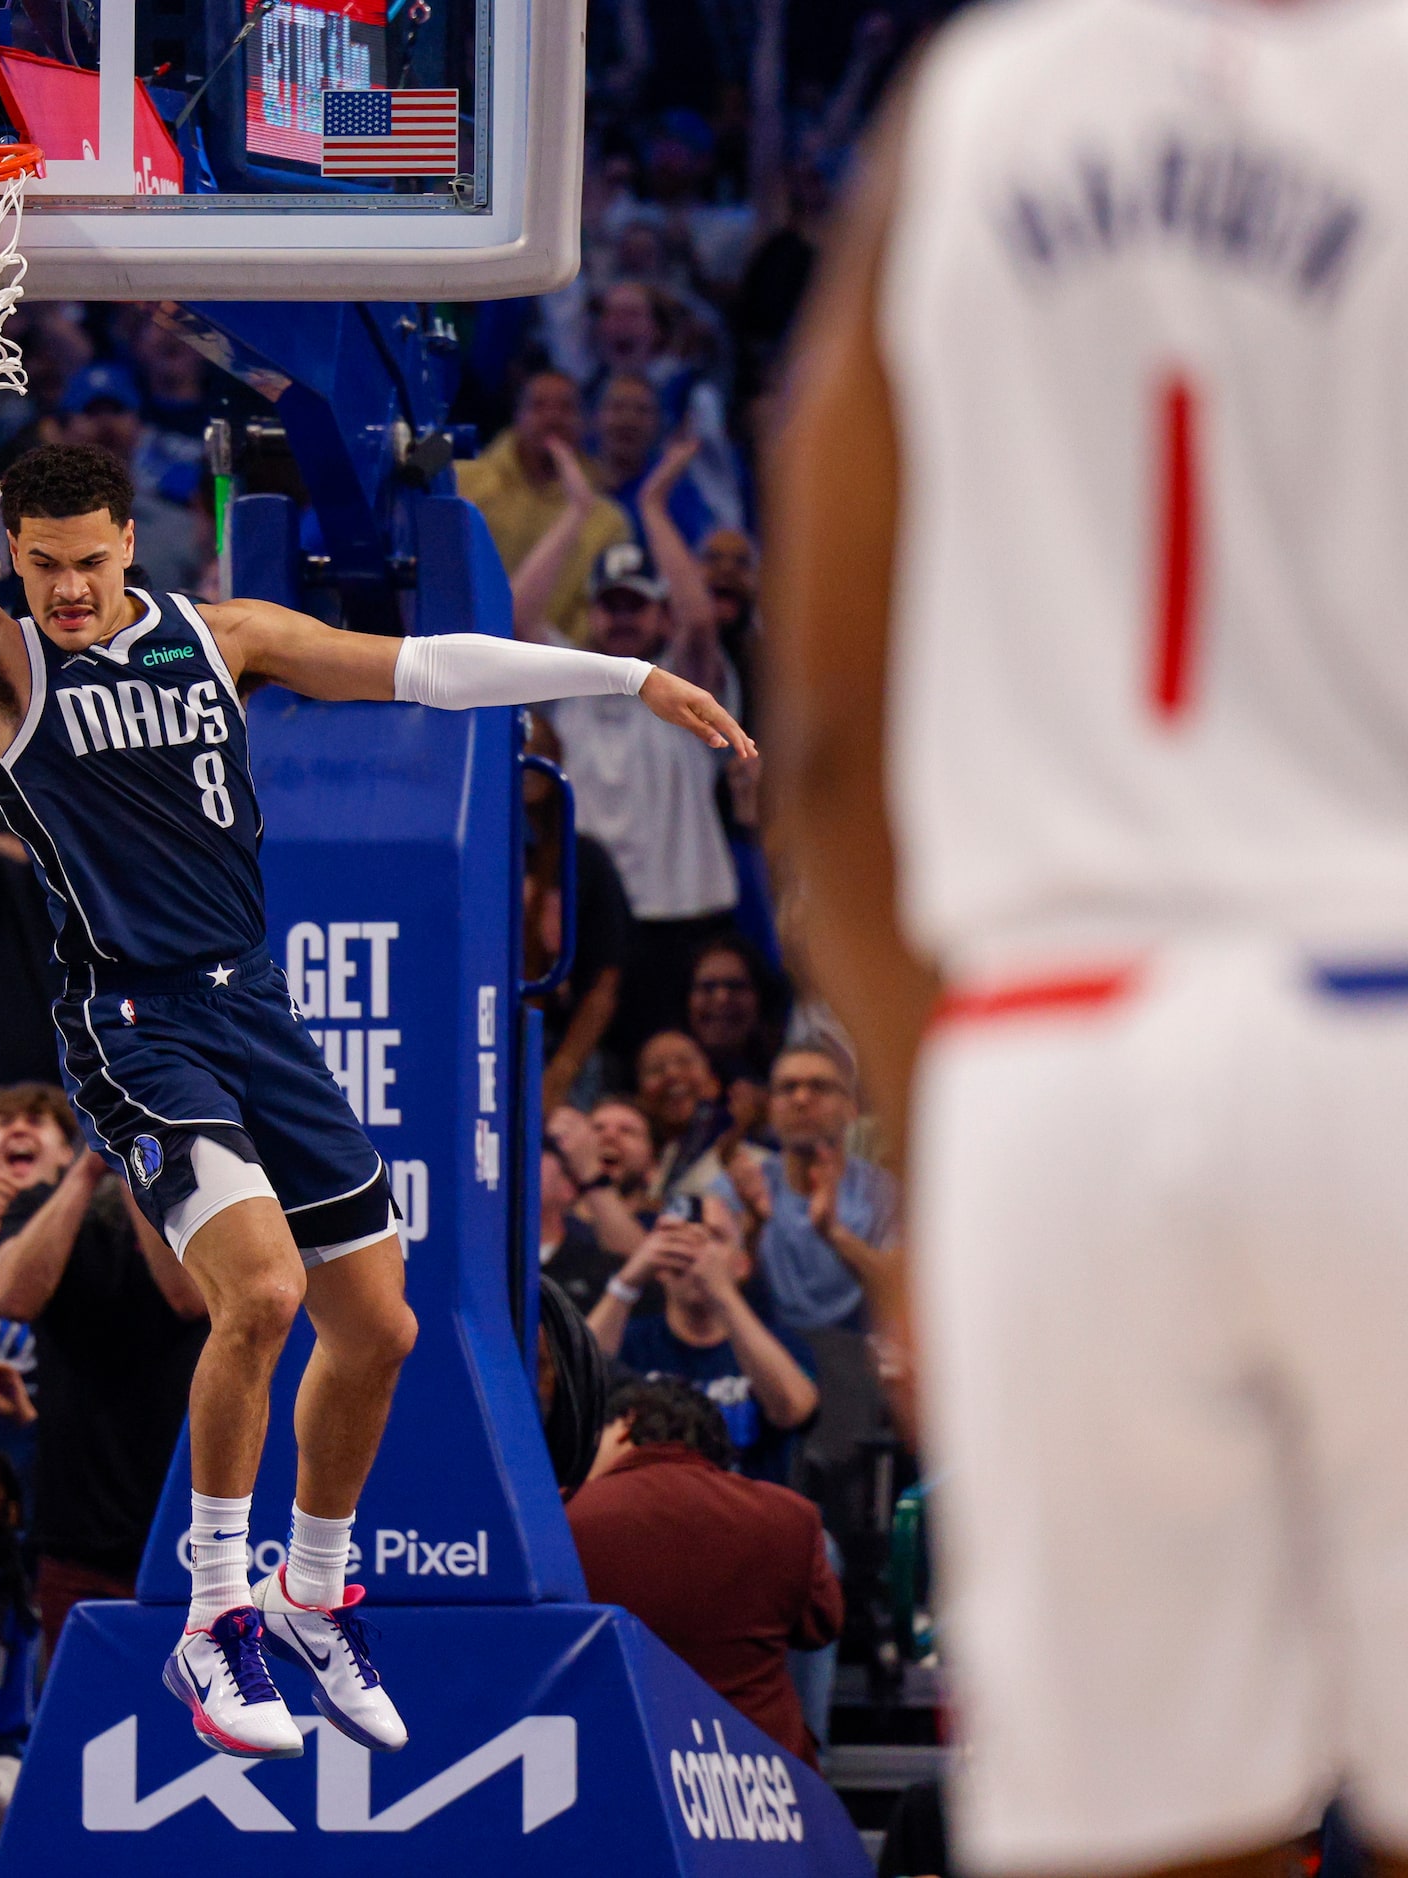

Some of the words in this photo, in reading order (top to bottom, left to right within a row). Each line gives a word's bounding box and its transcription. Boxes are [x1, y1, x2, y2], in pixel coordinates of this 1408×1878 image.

[143, 646, 195, 667] chime
[193, 750, 234, 829] 8
[286, 921, 400, 1019] GET
[375, 1529, 488, 1576] Pixel
[670, 1718, 804, 1843] coinbase
